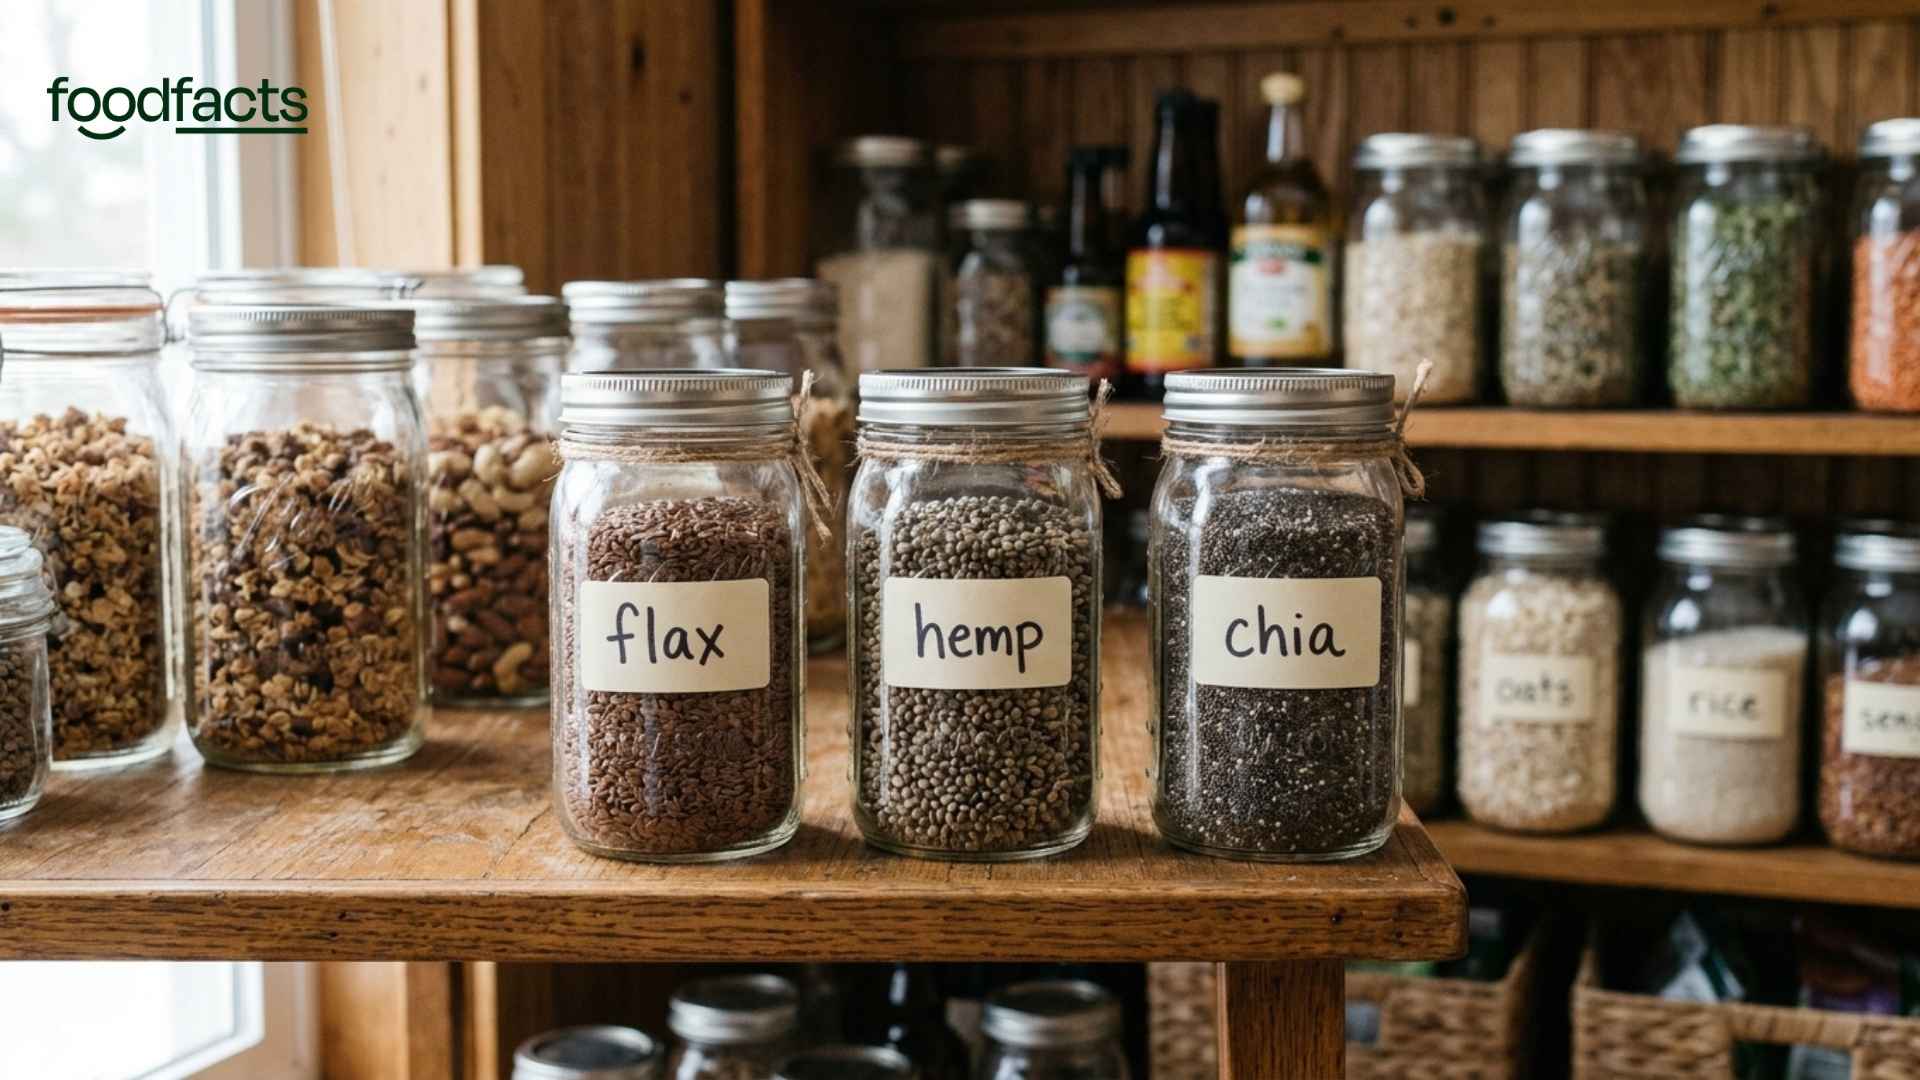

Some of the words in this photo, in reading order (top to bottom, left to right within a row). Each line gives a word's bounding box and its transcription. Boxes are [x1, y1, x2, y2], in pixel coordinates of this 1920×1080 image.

[607, 602, 726, 667] flax
[915, 603, 1044, 673] hemp
[1225, 604, 1347, 657] chia
[1496, 669, 1575, 707] oats
[1689, 691, 1757, 720] rice
